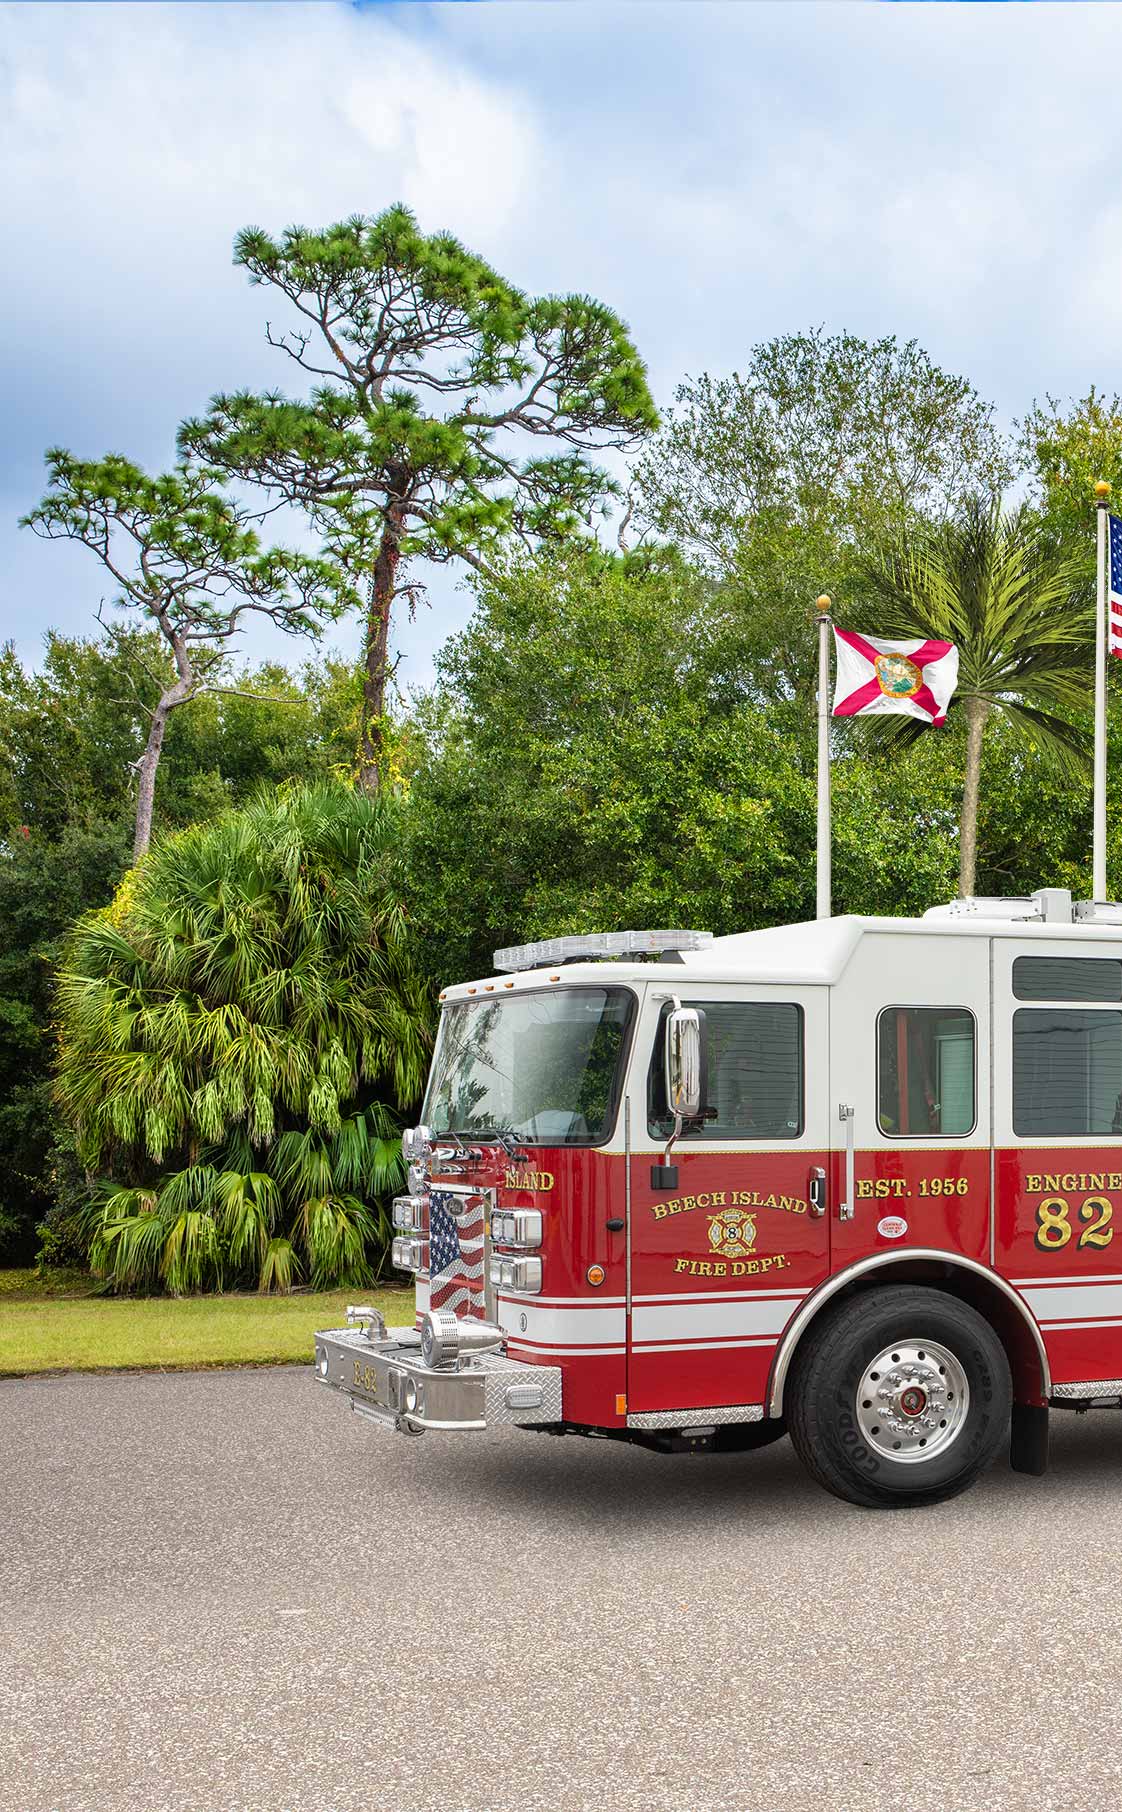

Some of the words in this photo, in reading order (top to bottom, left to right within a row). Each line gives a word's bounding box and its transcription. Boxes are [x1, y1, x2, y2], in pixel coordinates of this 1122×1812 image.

[504, 1170, 555, 1192] ISLAND
[856, 1179, 912, 1199] EST.
[919, 1177, 969, 1198] 1956
[1025, 1172, 1122, 1193] ENGINE
[651, 1192, 727, 1220] BEECH
[731, 1191, 808, 1215] ISLAND
[728, 1227, 737, 1239] 8
[1034, 1195, 1114, 1252] 82
[673, 1258, 727, 1277] FIRE
[731, 1254, 791, 1277] DEPT.
[353, 1359, 377, 1393] E-82
